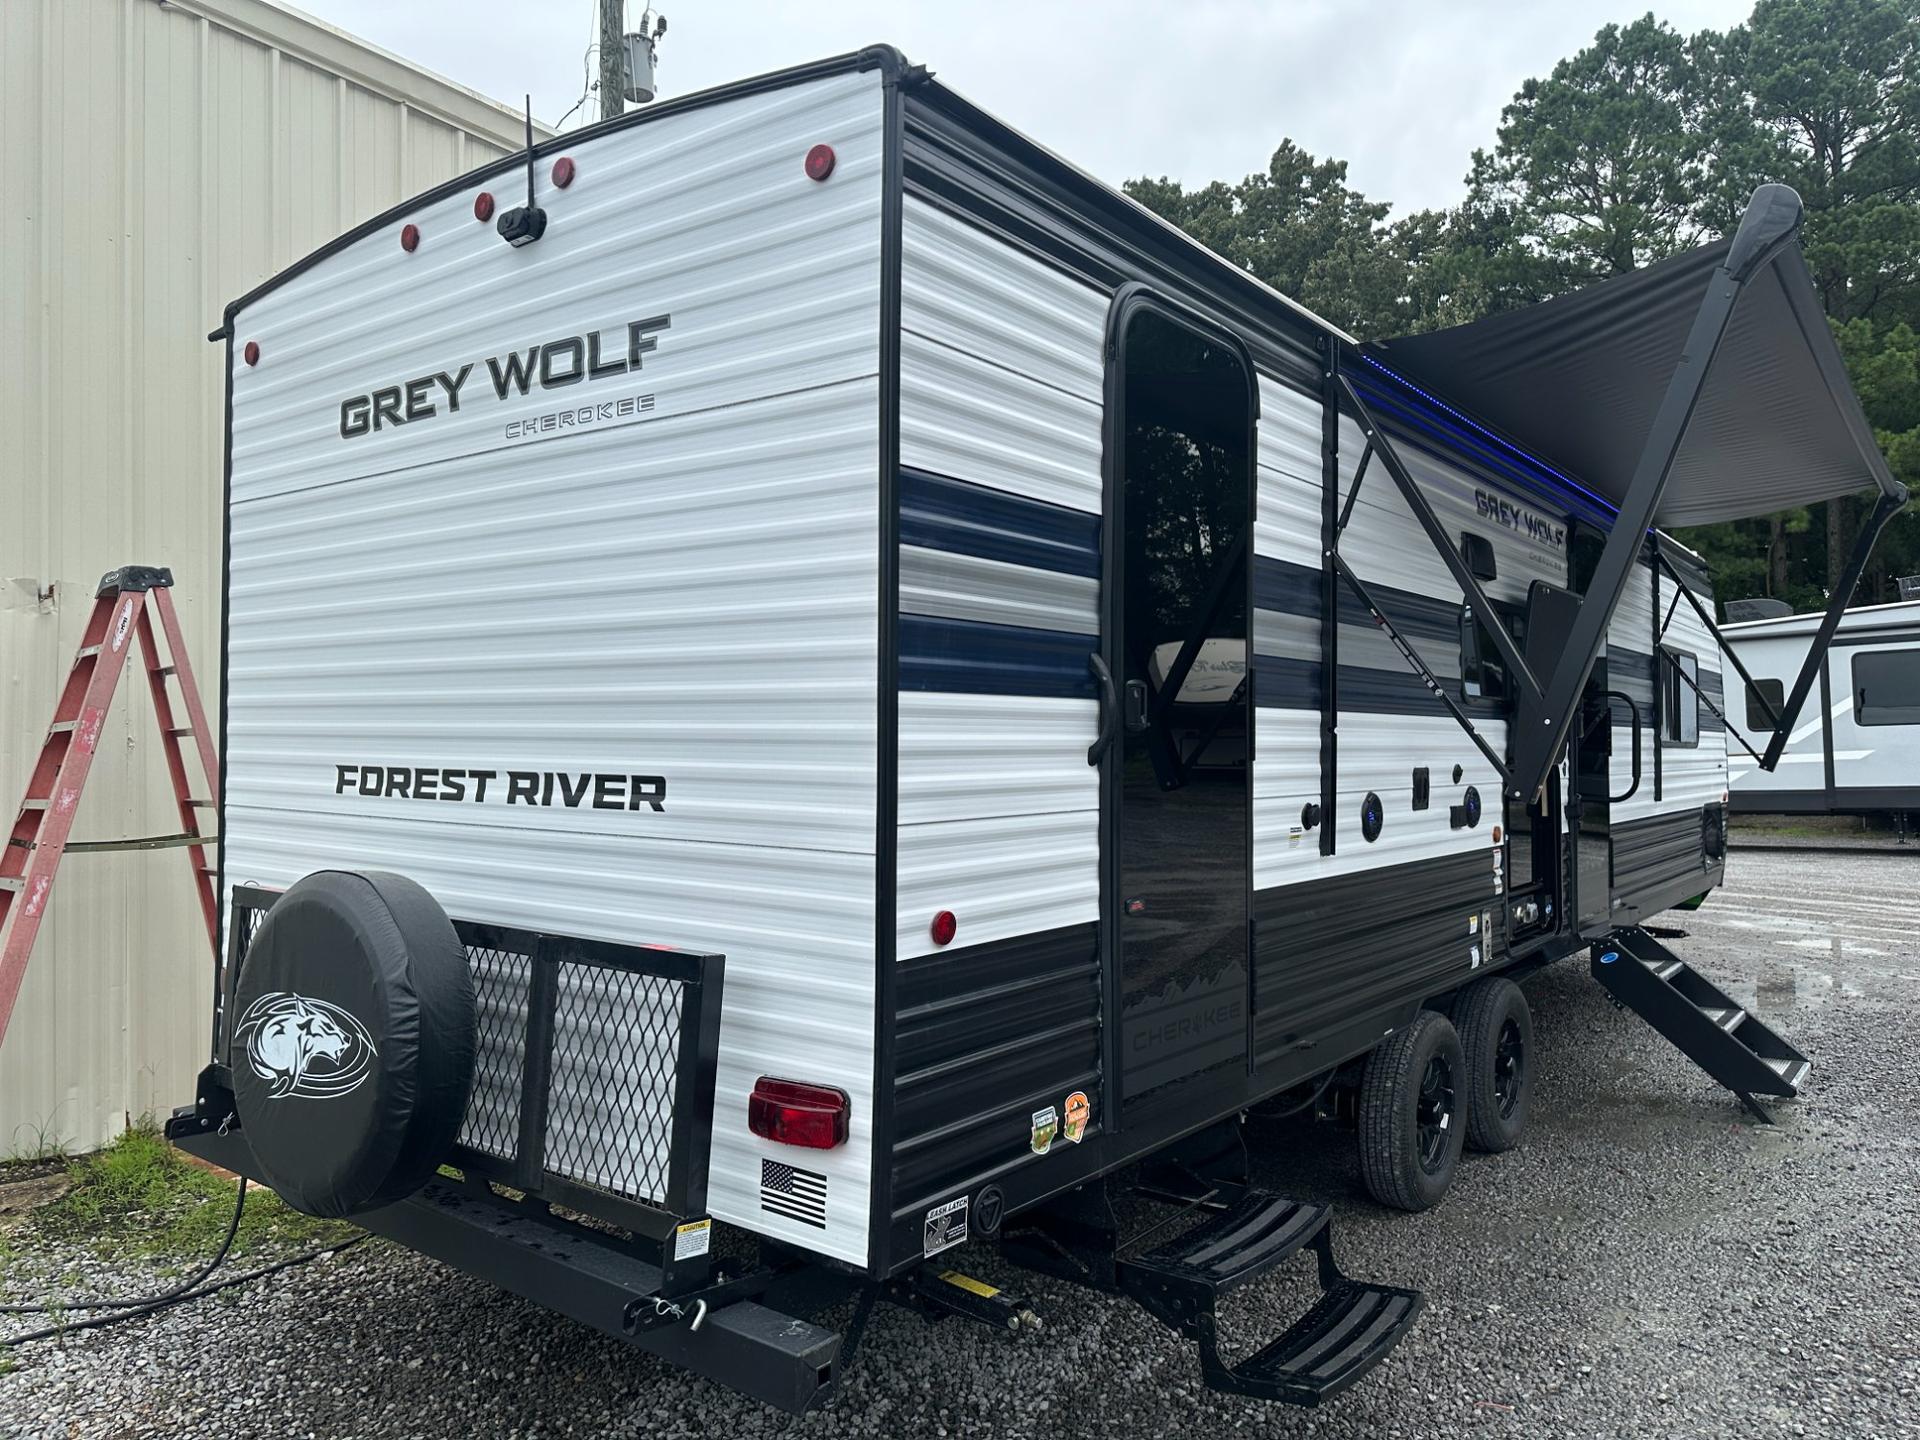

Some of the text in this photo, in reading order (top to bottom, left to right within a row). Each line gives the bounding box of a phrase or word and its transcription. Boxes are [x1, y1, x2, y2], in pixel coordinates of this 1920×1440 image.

[340, 313, 671, 439] GREY WOLF
[505, 394, 655, 439] CHEROKEE
[1475, 488, 1564, 549] GREY WOLF
[335, 765, 666, 812] FOREST RIVER
[948, 1198, 968, 1211] LATCH
